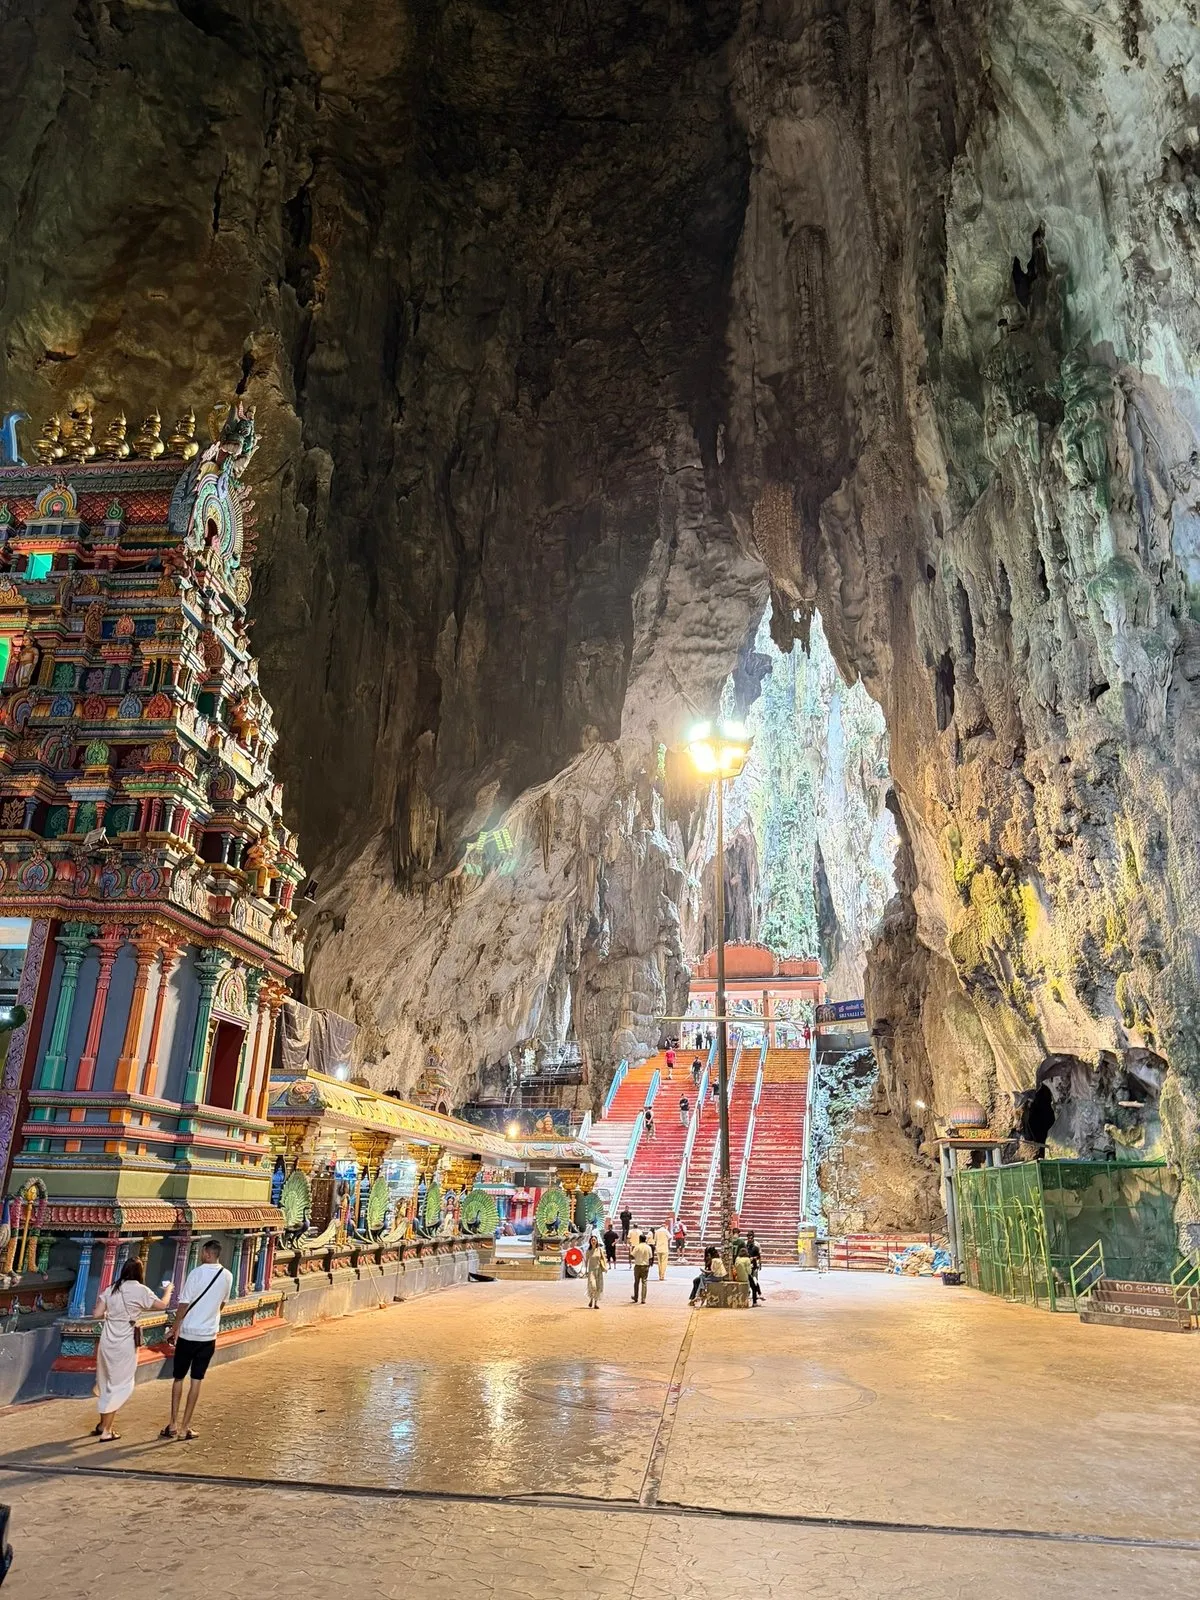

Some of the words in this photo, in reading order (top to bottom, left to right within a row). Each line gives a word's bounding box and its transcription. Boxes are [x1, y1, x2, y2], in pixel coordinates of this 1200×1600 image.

[1116, 1283, 1133, 1292] NO
[1136, 1284, 1173, 1295] SHOES
[1105, 1304, 1120, 1313] NO
[1124, 1305, 1161, 1317] SHOES
